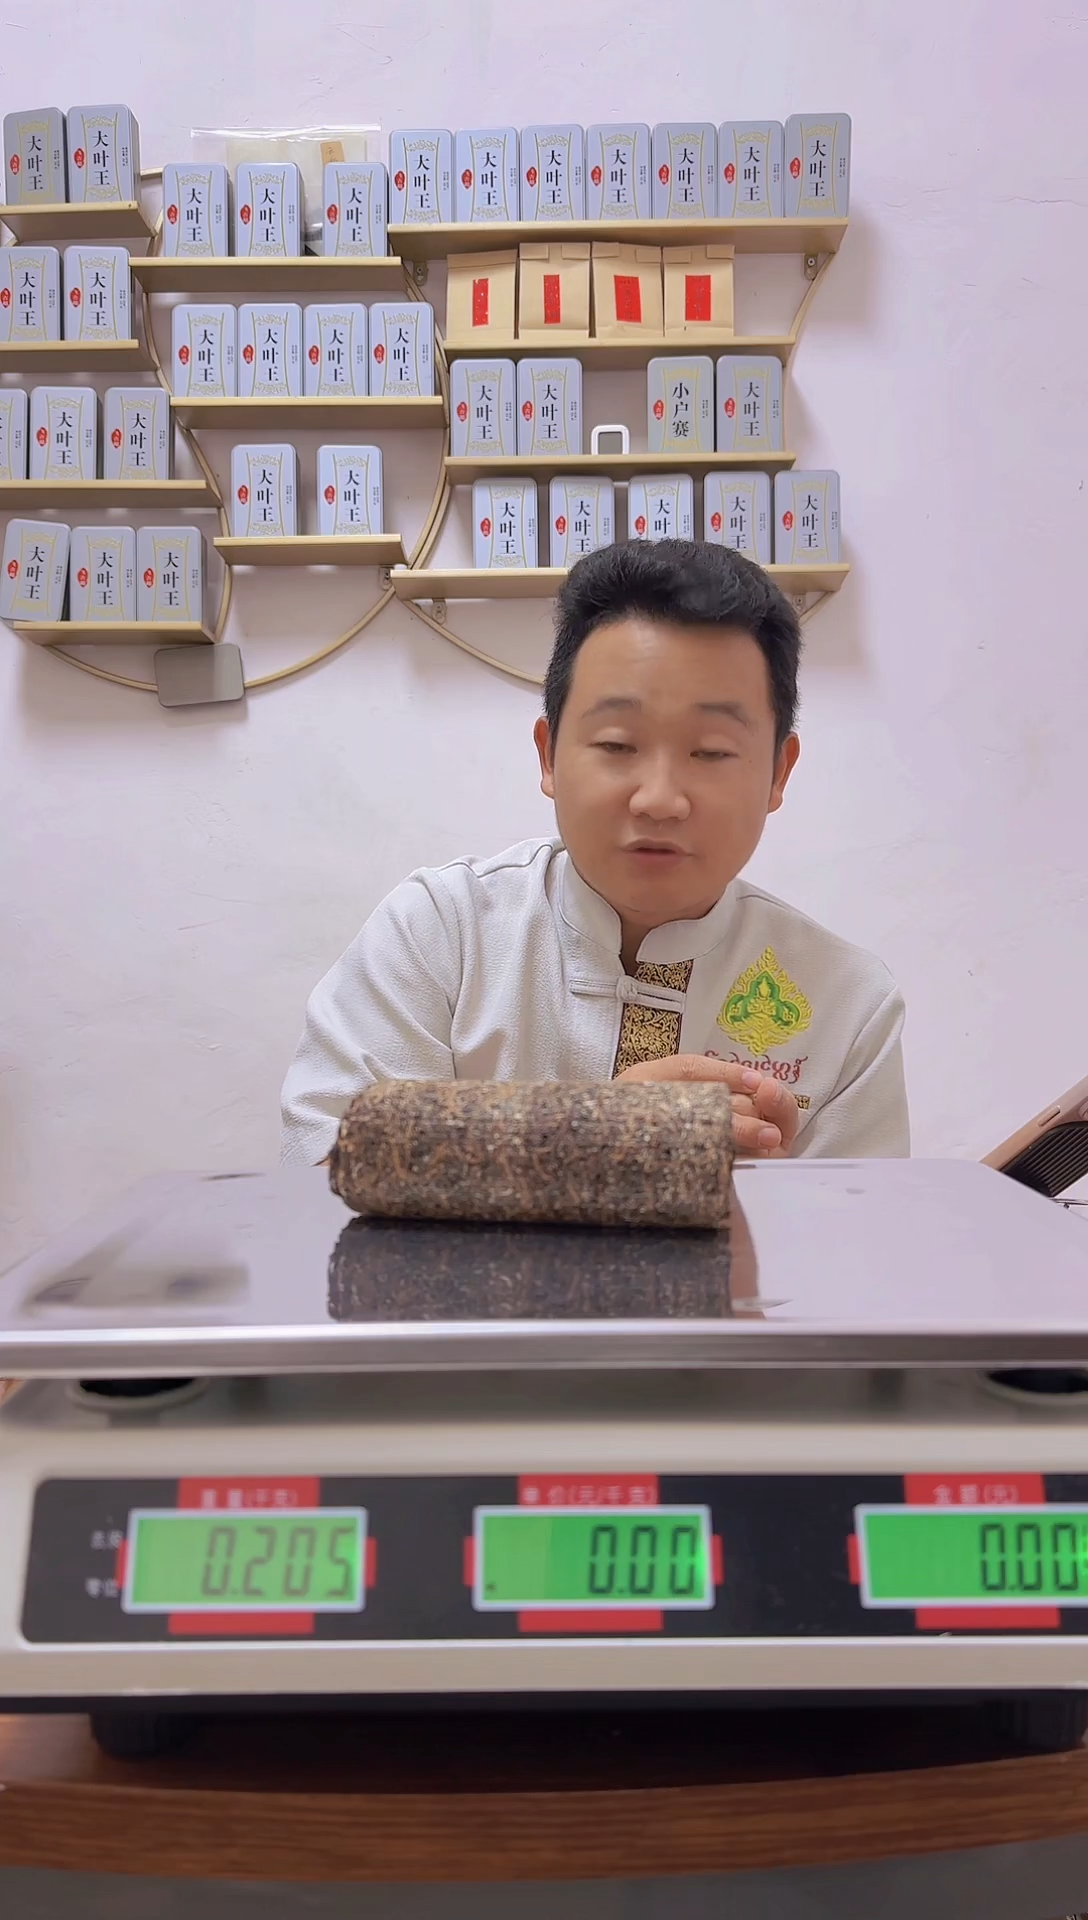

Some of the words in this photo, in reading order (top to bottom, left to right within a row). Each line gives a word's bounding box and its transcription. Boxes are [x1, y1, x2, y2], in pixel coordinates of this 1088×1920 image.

[27, 135, 43, 190] 大叶王
[93, 130, 110, 186] 大叶王
[413, 154, 431, 209] 大叶王
[480, 151, 498, 206] 大叶王
[545, 149, 563, 204] 大叶王
[610, 148, 628, 203] 大叶王
[678, 147, 695, 203] 大叶王
[743, 146, 761, 201] 大叶王
[809, 139, 827, 197] 大叶王
[186, 187, 203, 242] 大叶王
[259, 187, 276, 242] 大叶王
[346, 187, 363, 242] 大叶王
[19, 271, 36, 326] 大叶王
[89, 271, 107, 326] 大叶王
[198, 329, 215, 382] 大叶王
[262, 328, 279, 382] 大叶王
[327, 328, 345, 382] 大叶王
[393, 327, 410, 381] 大叶王
[476, 384, 493, 440] 大叶王
[541, 384, 558, 439] 大叶王
[672, 382, 690, 438] 小户赛
[743, 381, 760, 436] 大叶王
[56, 411, 73, 465] 大叶王
[130, 412, 147, 467] 大叶王
[257, 468, 274, 522] 大叶王
[343, 469, 361, 523] 大叶王
[654, 498, 671, 541] 大叶
[802, 494, 819, 548] 大叶王
[499, 501, 516, 554] 大叶王
[574, 500, 592, 555] 大叶王
[729, 496, 747, 552] 大叶王
[26, 546, 45, 600] 大叶王
[97, 551, 114, 605] 大叶王
[162, 551, 180, 606] 大叶王
[201, 1526, 355, 1597] 0.205
[587, 1525, 697, 1595] 0.00
[980, 1522, 1079, 1592] 0.00
